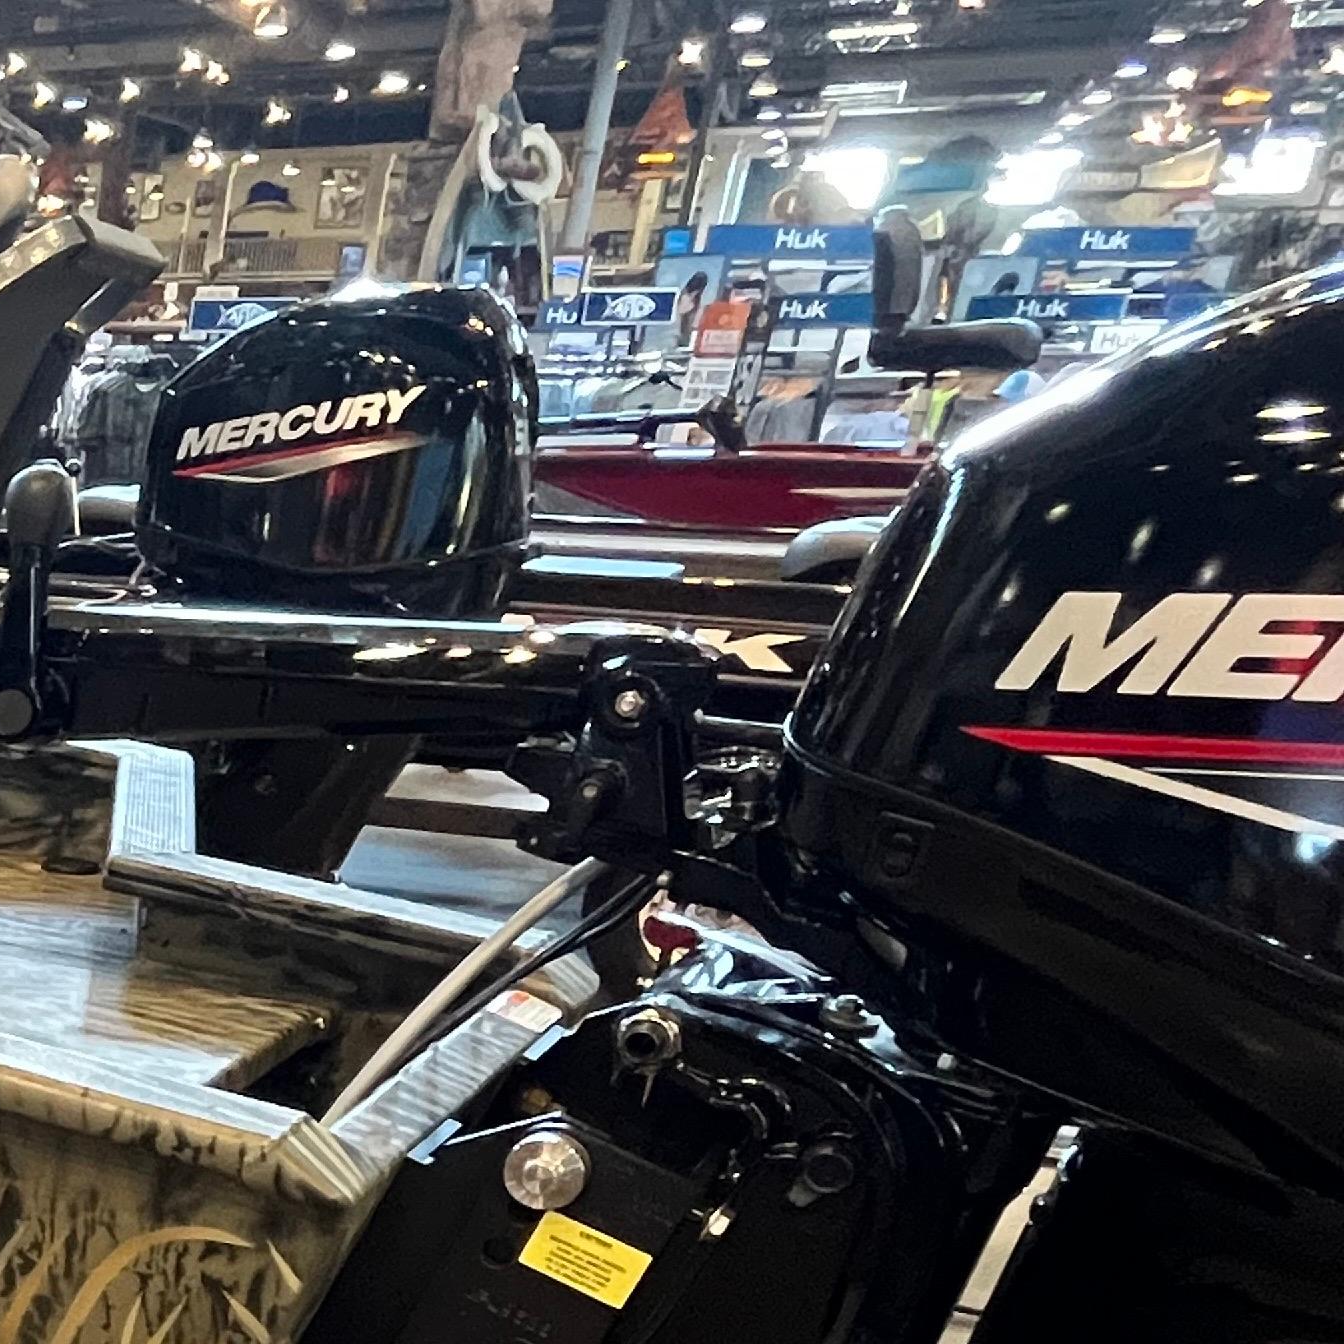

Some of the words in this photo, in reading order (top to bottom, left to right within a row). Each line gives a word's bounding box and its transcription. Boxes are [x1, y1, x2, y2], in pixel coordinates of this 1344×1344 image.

[775, 228, 830, 250] Huk
[1079, 231, 1130, 250] Huk
[546, 307, 578, 326] Hu
[778, 299, 828, 320] Huk
[1015, 302, 1068, 319] Huk
[176, 385, 427, 460] MERCURY
